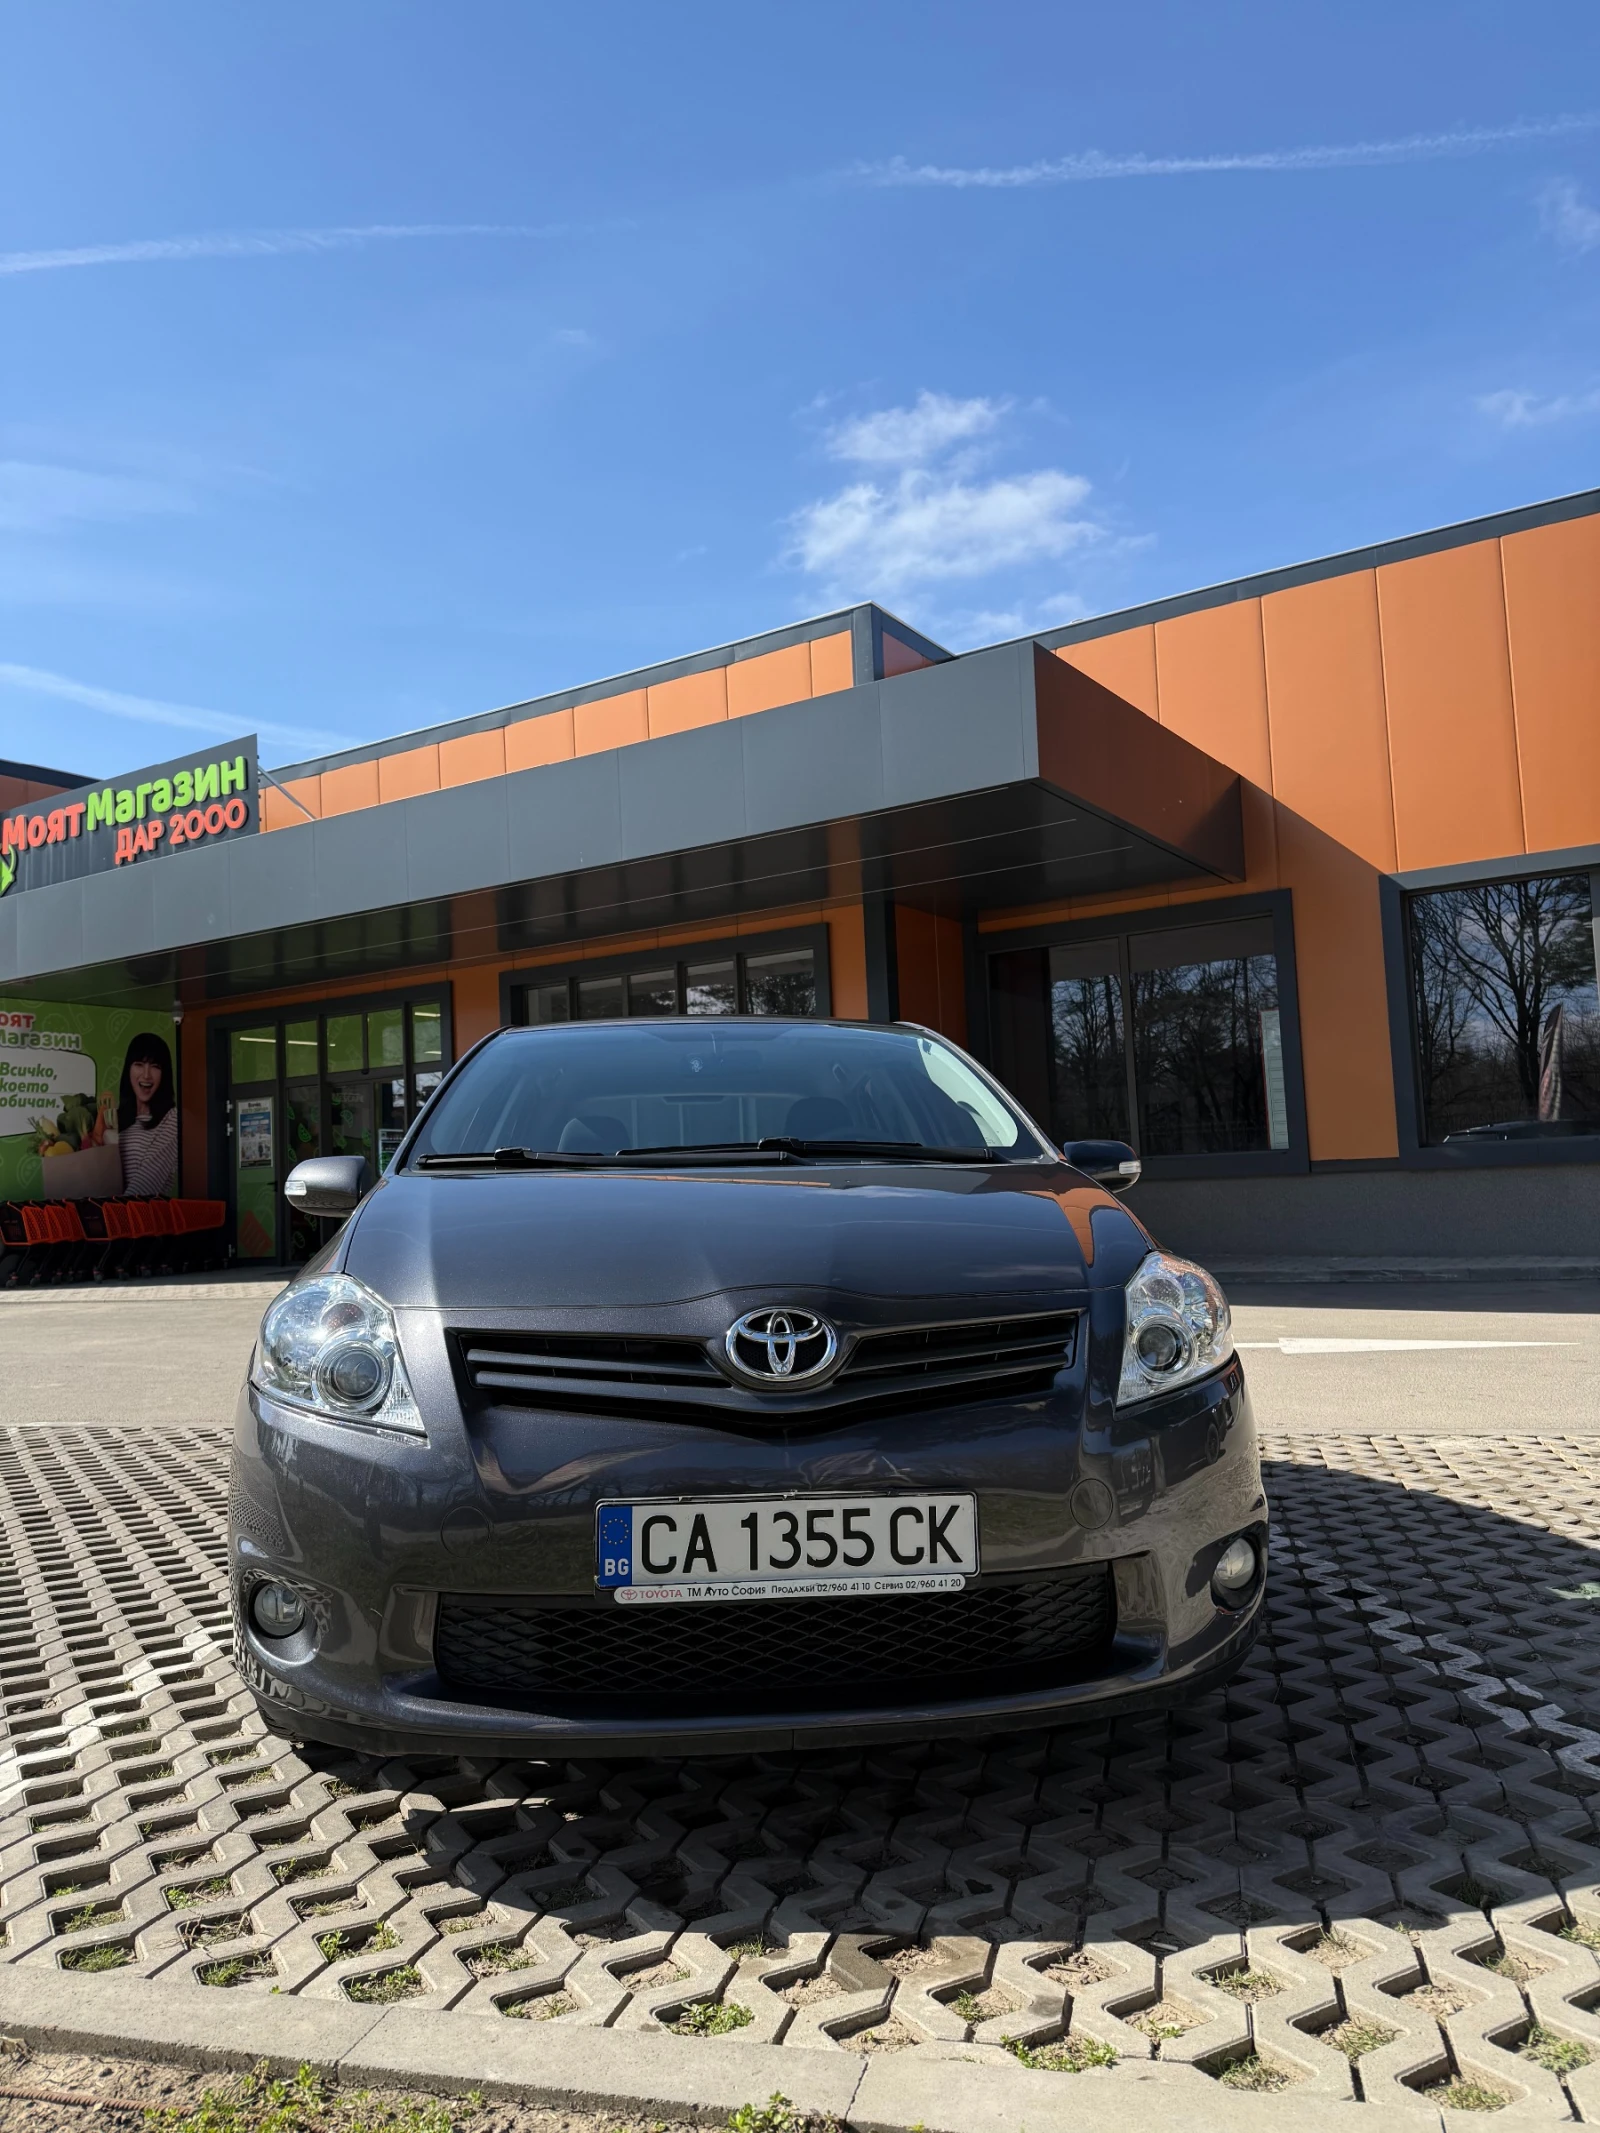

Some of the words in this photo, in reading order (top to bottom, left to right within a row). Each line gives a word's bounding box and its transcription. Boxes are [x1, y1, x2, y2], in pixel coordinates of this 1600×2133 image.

[114, 820, 165, 865] ДАР
[169, 798, 248, 845] 2000
[0, 1061, 58, 1081] Всичко,
[0, 1078, 49, 1093] което
[0, 1093, 60, 1108] обичам.
[740, 1508, 875, 1571] 1355
[604, 1558, 629, 1576] BG
[640, 1589, 683, 1598] TOYOTA
[816, 1583, 848, 1592] 02/960
[850, 1582, 859, 1591] 41
[861, 1582, 870, 1590] 10
[905, 1579, 936, 1590] 02/960
[938, 1579, 948, 1587] 41
[950, 1578, 961, 1587] 20
